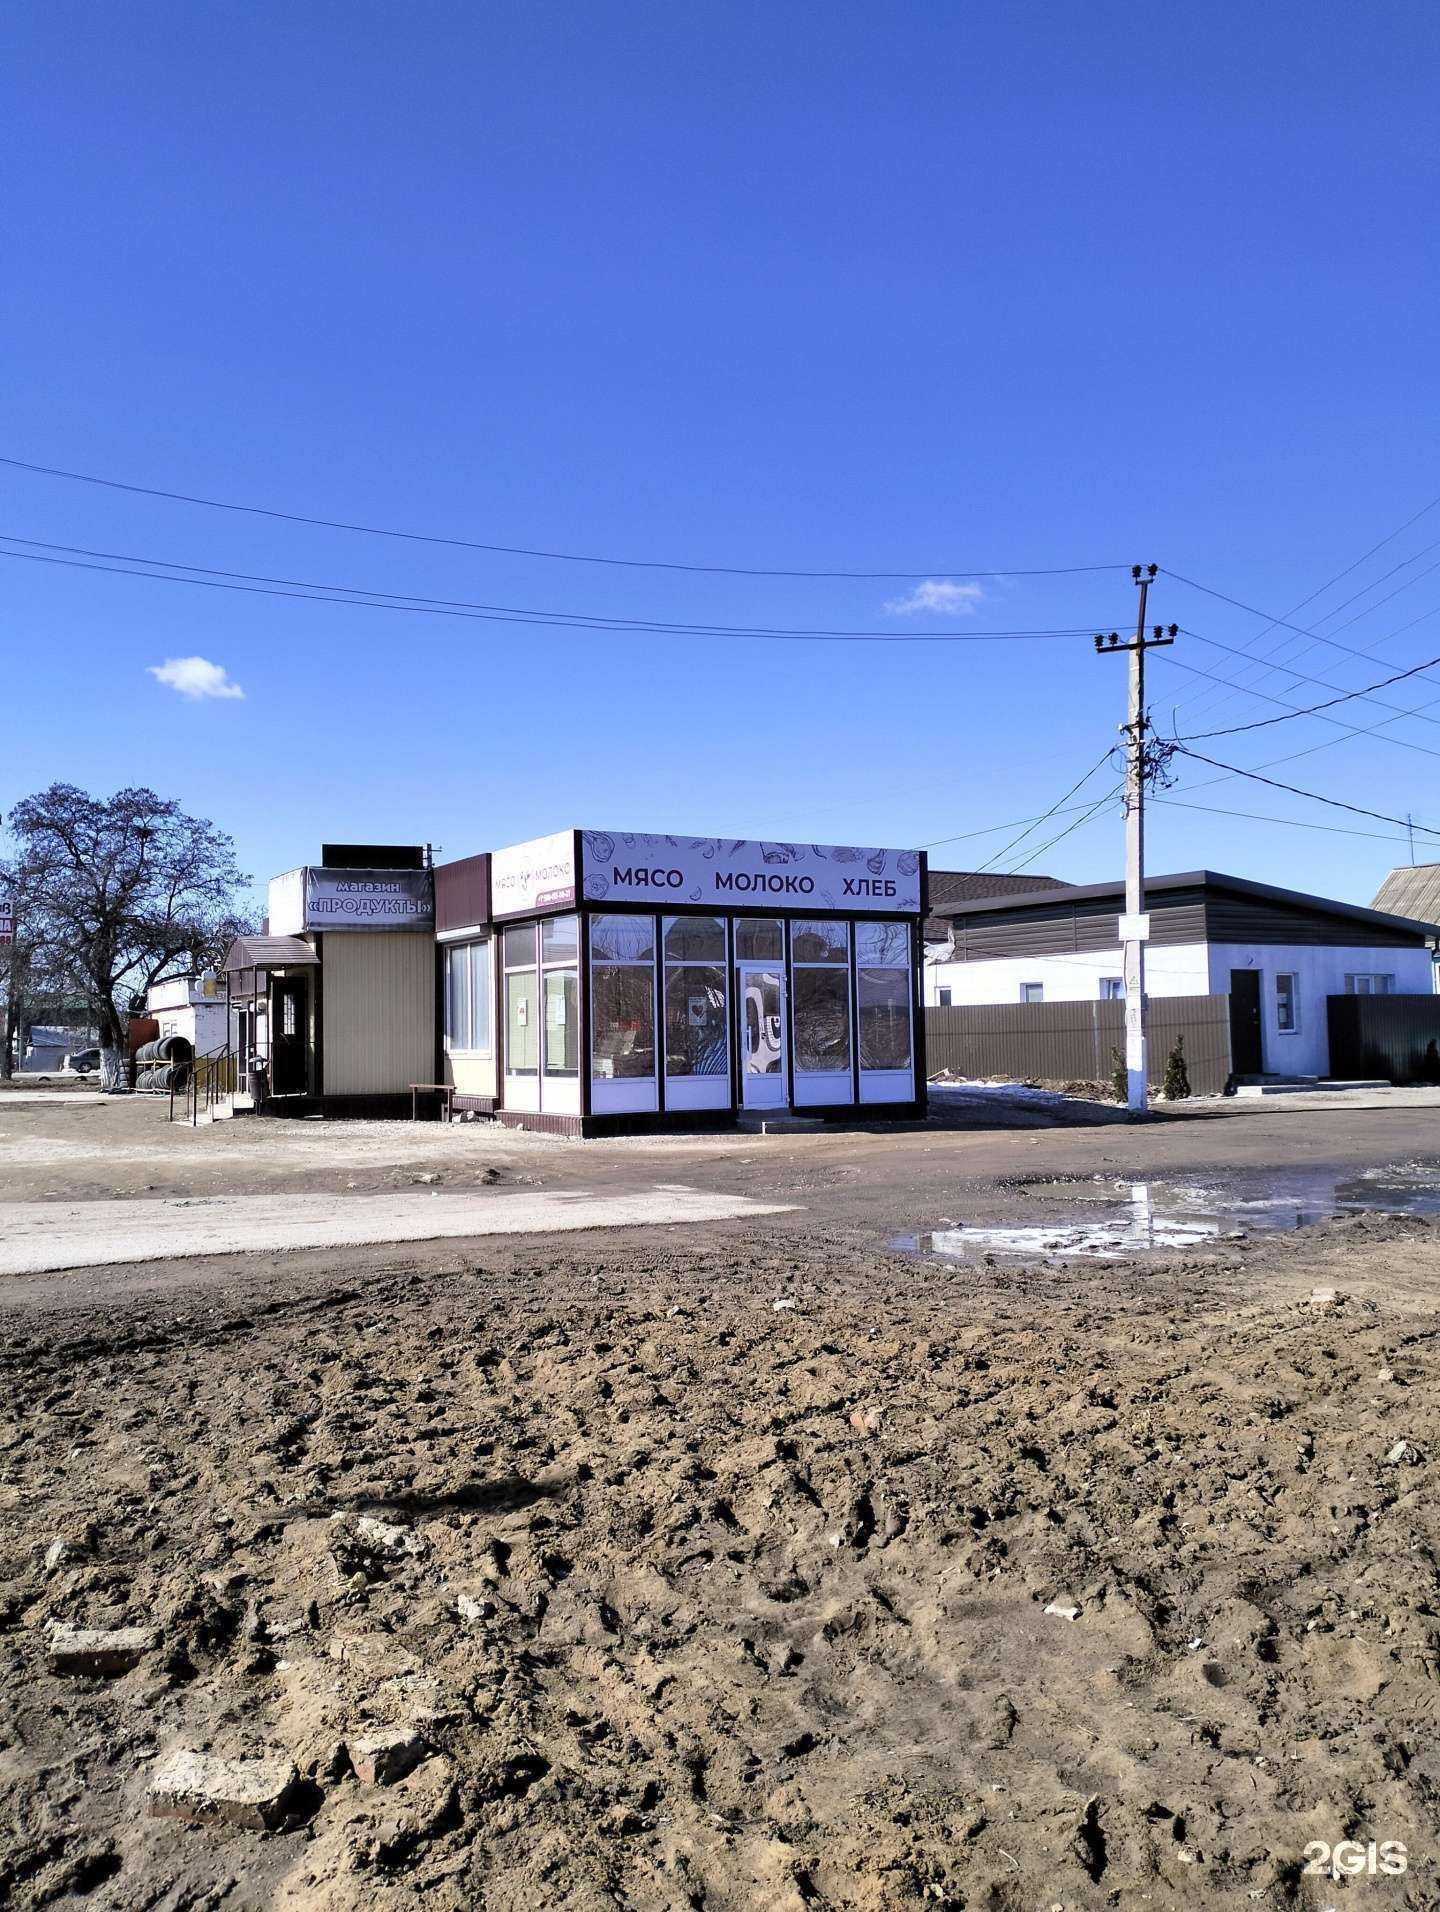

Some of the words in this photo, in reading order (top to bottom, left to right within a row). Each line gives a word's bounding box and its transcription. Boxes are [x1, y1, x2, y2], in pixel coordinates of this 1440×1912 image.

[336, 881, 401, 892] магазин
[612, 866, 684, 888] МЯСО
[714, 871, 815, 893] МОЛОКО
[842, 878, 897, 897] ХЛЕБ
[309, 897, 432, 916] «ПРОДУКТЫ»
